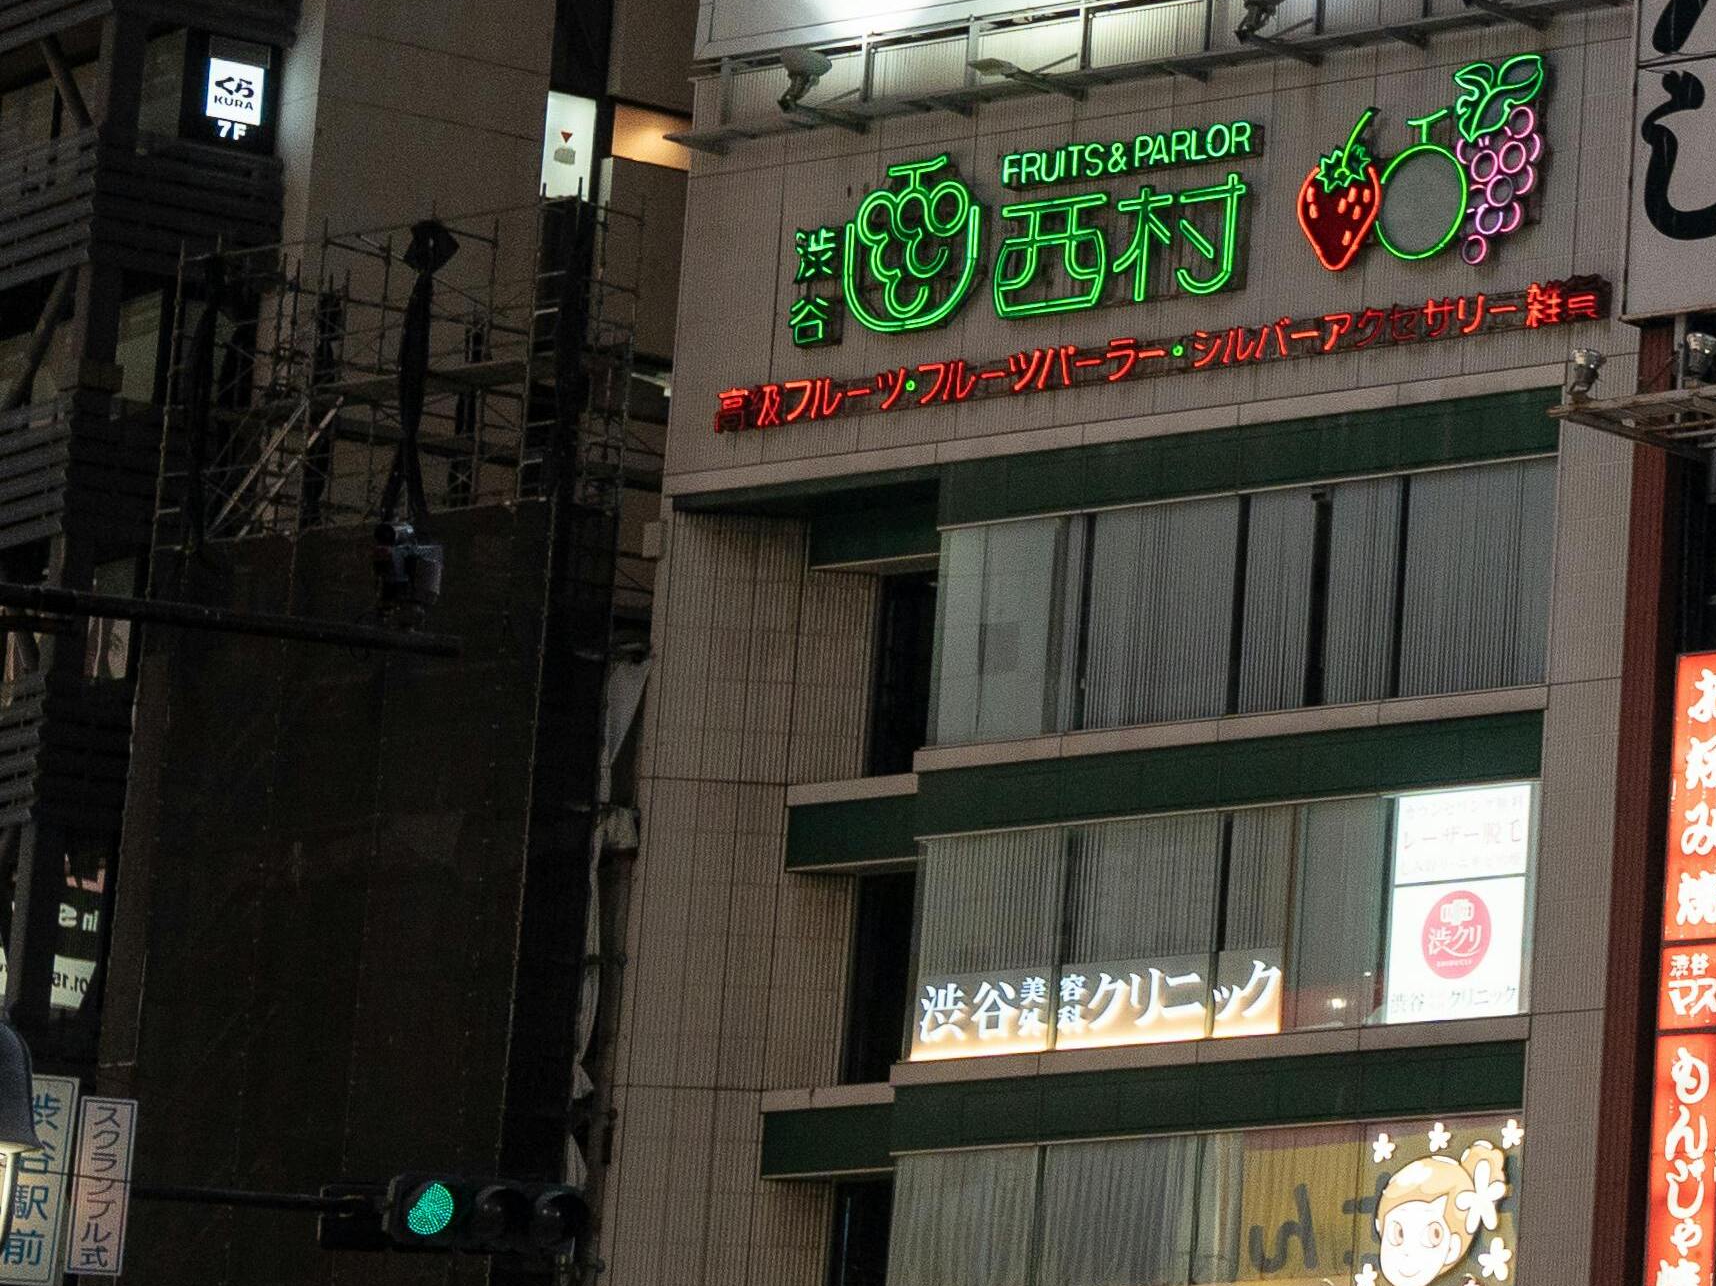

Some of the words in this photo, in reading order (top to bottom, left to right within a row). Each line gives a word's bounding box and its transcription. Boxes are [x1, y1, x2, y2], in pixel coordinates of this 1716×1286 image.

[214, 95, 253, 111] KURA
[217, 119, 248, 141] 7F
[1133, 120, 1252, 168] PARLOR
[794, 229, 838, 345] 渋谷
[994, 173, 1249, 320] 西村
[80, 1105, 122, 1269] スクランブル式
